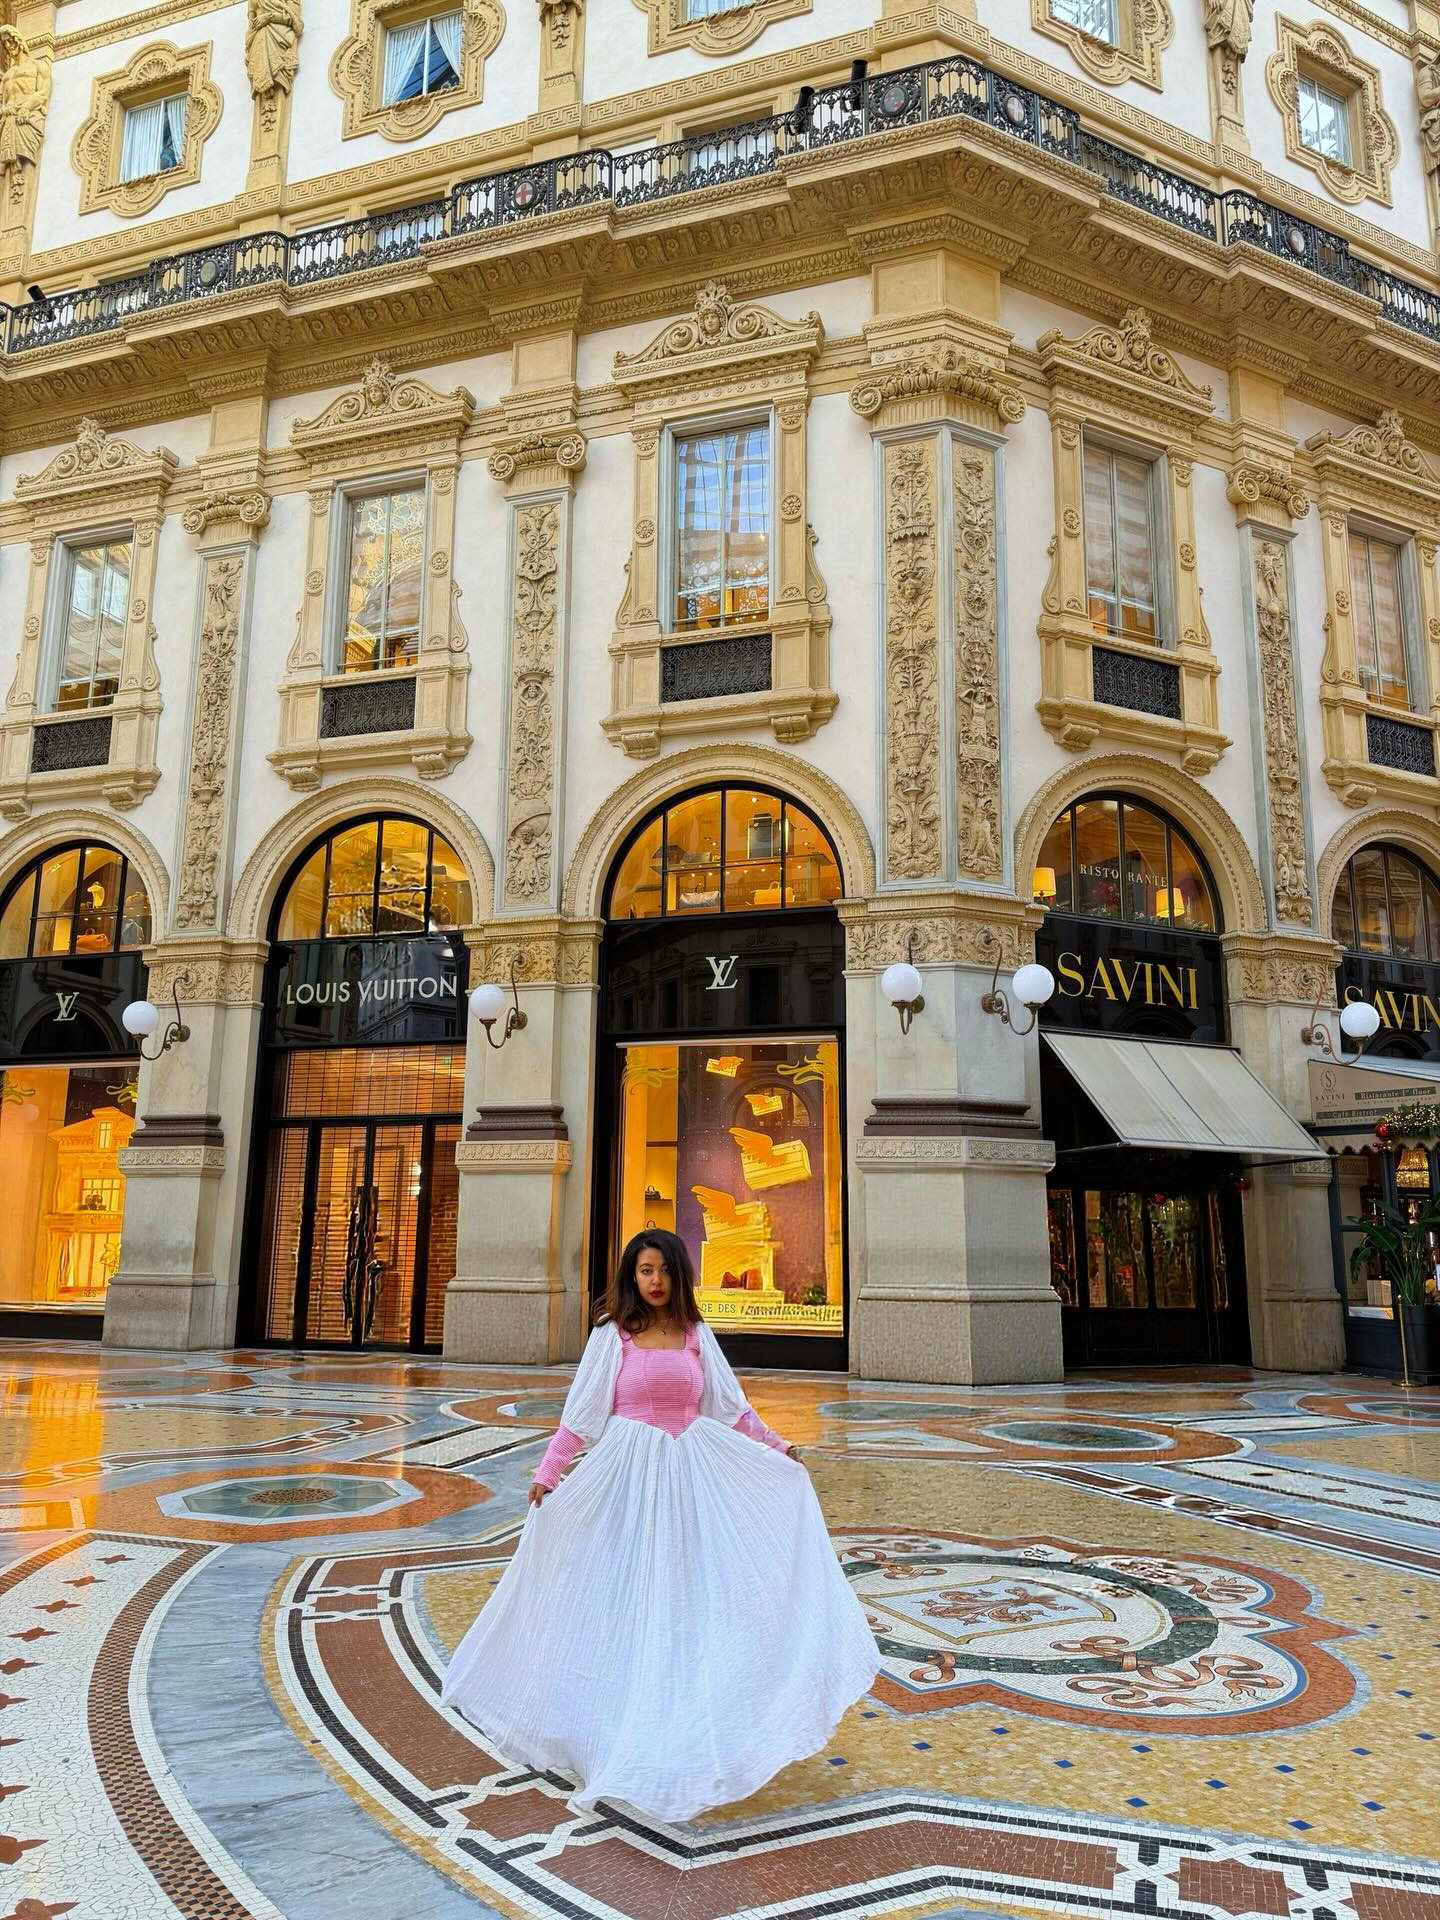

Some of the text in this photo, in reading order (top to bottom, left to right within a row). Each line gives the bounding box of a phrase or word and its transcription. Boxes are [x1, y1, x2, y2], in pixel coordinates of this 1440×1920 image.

[1079, 863, 1168, 888] RISTORANTE
[706, 955, 739, 990] LV
[1057, 952, 1200, 1010] SAVINI
[286, 975, 458, 1006] LOUIS VUITTON
[52, 991, 80, 1022] LV
[718, 1303, 736, 1314] DES
